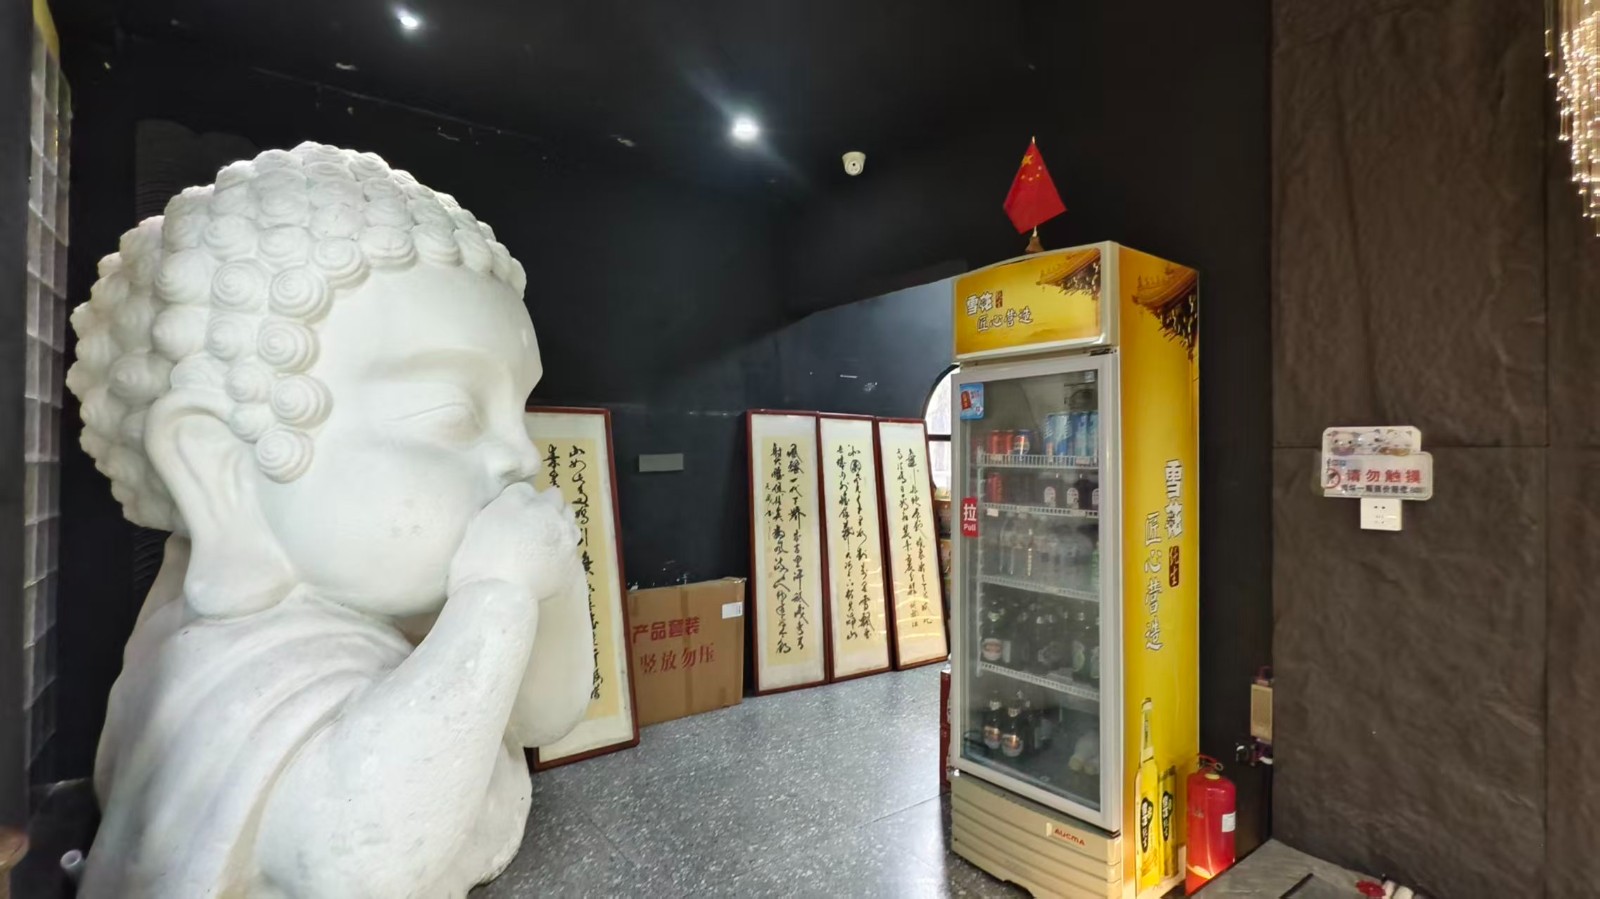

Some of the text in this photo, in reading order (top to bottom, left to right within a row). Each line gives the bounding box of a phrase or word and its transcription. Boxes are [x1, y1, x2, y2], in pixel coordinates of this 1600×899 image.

[977, 305, 1034, 332] 匠心营造
[1347, 469, 1421, 484] 请勿触摸
[963, 503, 977, 521] 拉
[963, 523, 977, 532] Pull
[1144, 511, 1163, 650] 匠心营造
[633, 616, 700, 644] 产品套装
[640, 642, 716, 674] 竖放勿压
